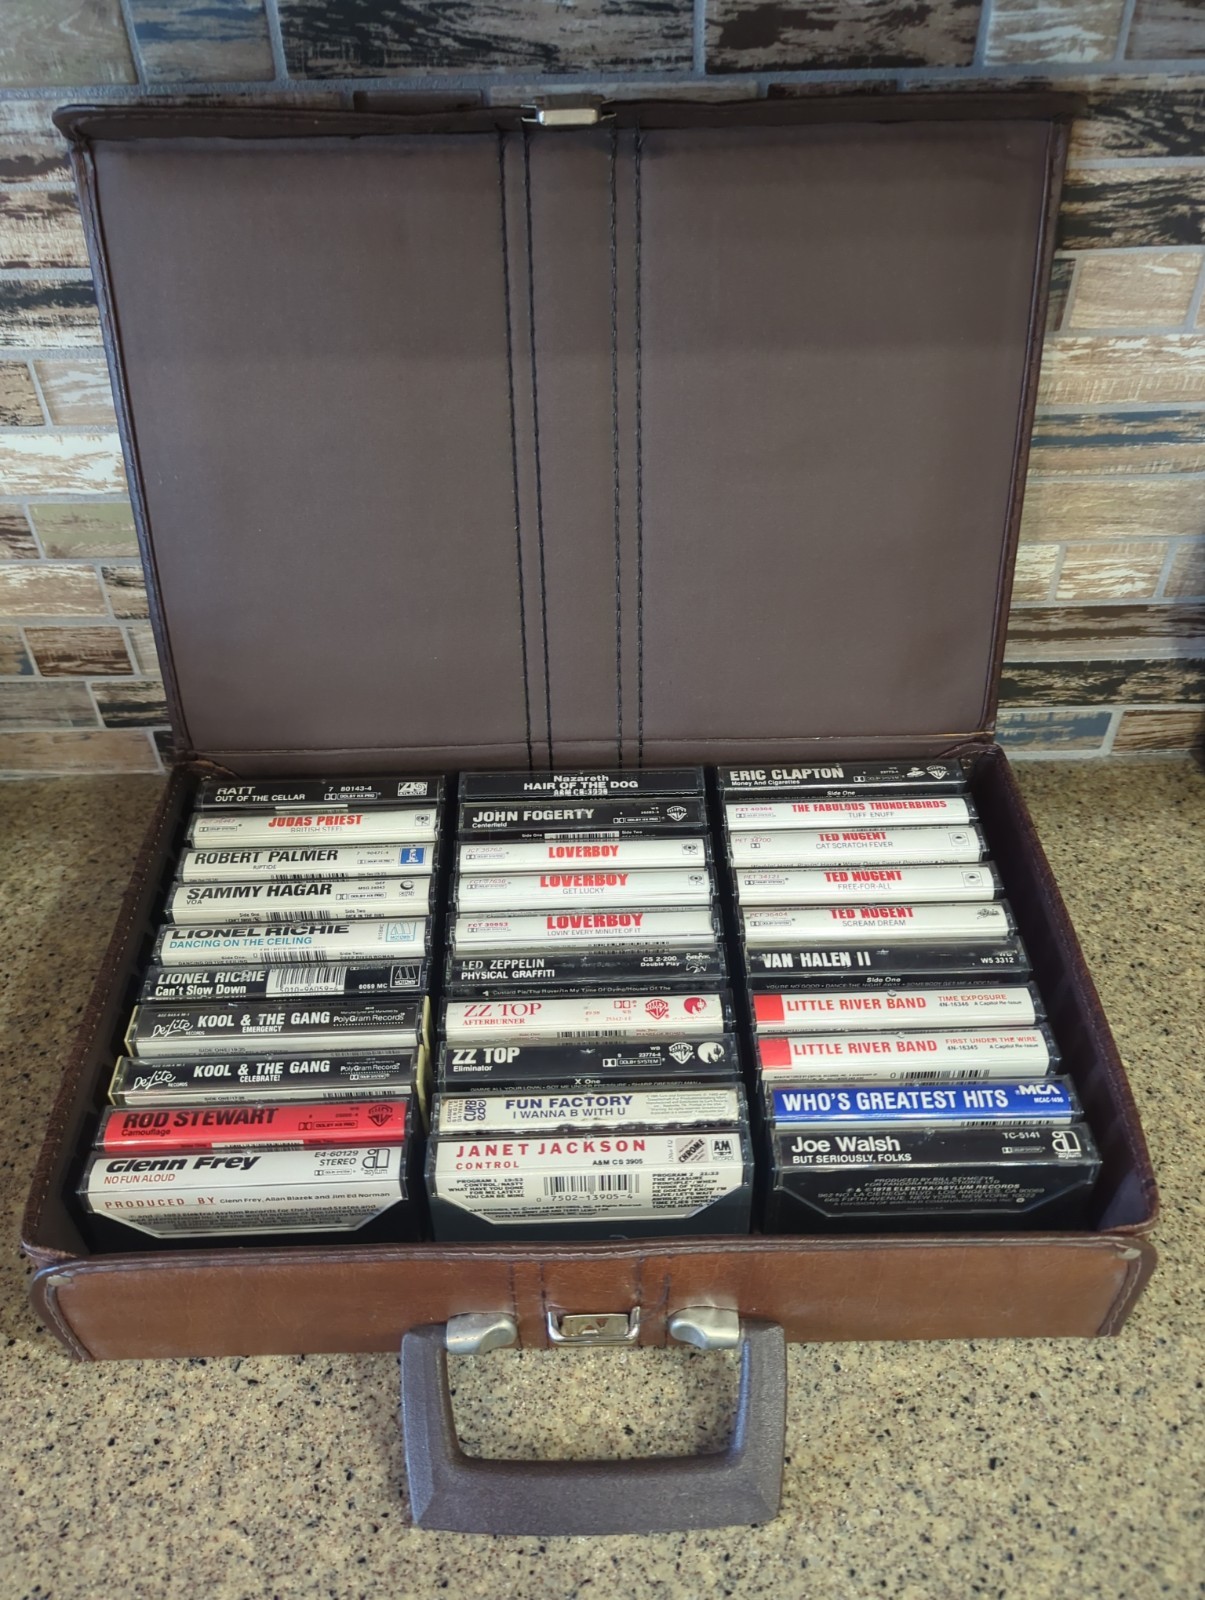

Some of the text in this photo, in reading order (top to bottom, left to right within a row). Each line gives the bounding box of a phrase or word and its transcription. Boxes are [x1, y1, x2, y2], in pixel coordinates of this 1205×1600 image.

[730, 768, 844, 780] ERIC CLAPTON
[813, 803, 866, 812] FABULOUS
[869, 800, 947, 810] THUNDERBIRDS
[268, 815, 363, 827] JUDAS PRIEST
[472, 809, 594, 822] JOHN FOGERTY
[818, 832, 886, 842] TED NUGENT
[194, 849, 338, 864] ROBERT PALMER
[548, 845, 619, 858] LOVERBOY
[540, 873, 628, 887] LOVERBOY
[824, 871, 902, 882] TED NUGENT
[187, 884, 332, 899] SAMMY HAGAR
[830, 907, 913, 919] TED NUGENT
[547, 913, 644, 929] LOVERBOY
[172, 925, 350, 940] LIONEL RICHIE
[169, 940, 220, 948] DANCING
[267, 937, 312, 945] CEILING
[462, 959, 544, 970] LED ZEPPELIN
[762, 952, 871, 968] VAN HALEN II
[158, 971, 266, 984] LIONEL RICHIE
[461, 970, 554, 980] PHYSICAL GRAFFITI
[155, 984, 246, 997] Can't Slow Down
[464, 1003, 542, 1017] ZZ TOP
[787, 997, 926, 1011] LITTLE RIVER BAND
[198, 1012, 330, 1028] KOOL & THE GANG
[794, 1040, 937, 1055] LITTLE RIVER BAND
[452, 1048, 520, 1064] ZZ TOP
[193, 1060, 330, 1077] KOOL & THE GANG
[1019, 1084, 1061, 1095] MCA
[505, 1099, 542, 1109] FUN
[549, 1095, 633, 1108] FACTORY
[782, 1089, 1008, 1111] WHO'S GREATEST HITS
[464, 1100, 476, 1121] CURB
[520, 1110, 566, 1119] WANNA
[583, 1108, 613, 1116] WITH
[122, 1108, 279, 1128] ROD STEWART
[121, 1128, 171, 1137] Camouflage
[456, 1140, 645, 1158] JANET JACKSON
[678, 1138, 706, 1163] CHROME
[791, 1136, 901, 1153] Joe Walsh
[106, 1156, 261, 1173] Glenn Frey
[320, 1158, 357, 1166] STEREO
[793, 1153, 912, 1164] BUT SERIOUSLY, FOLKS
[456, 1161, 520, 1170] CONTROL
[104, 1174, 176, 1184] NO FUN ALOUD
[105, 1199, 184, 1209] PRODUCED
